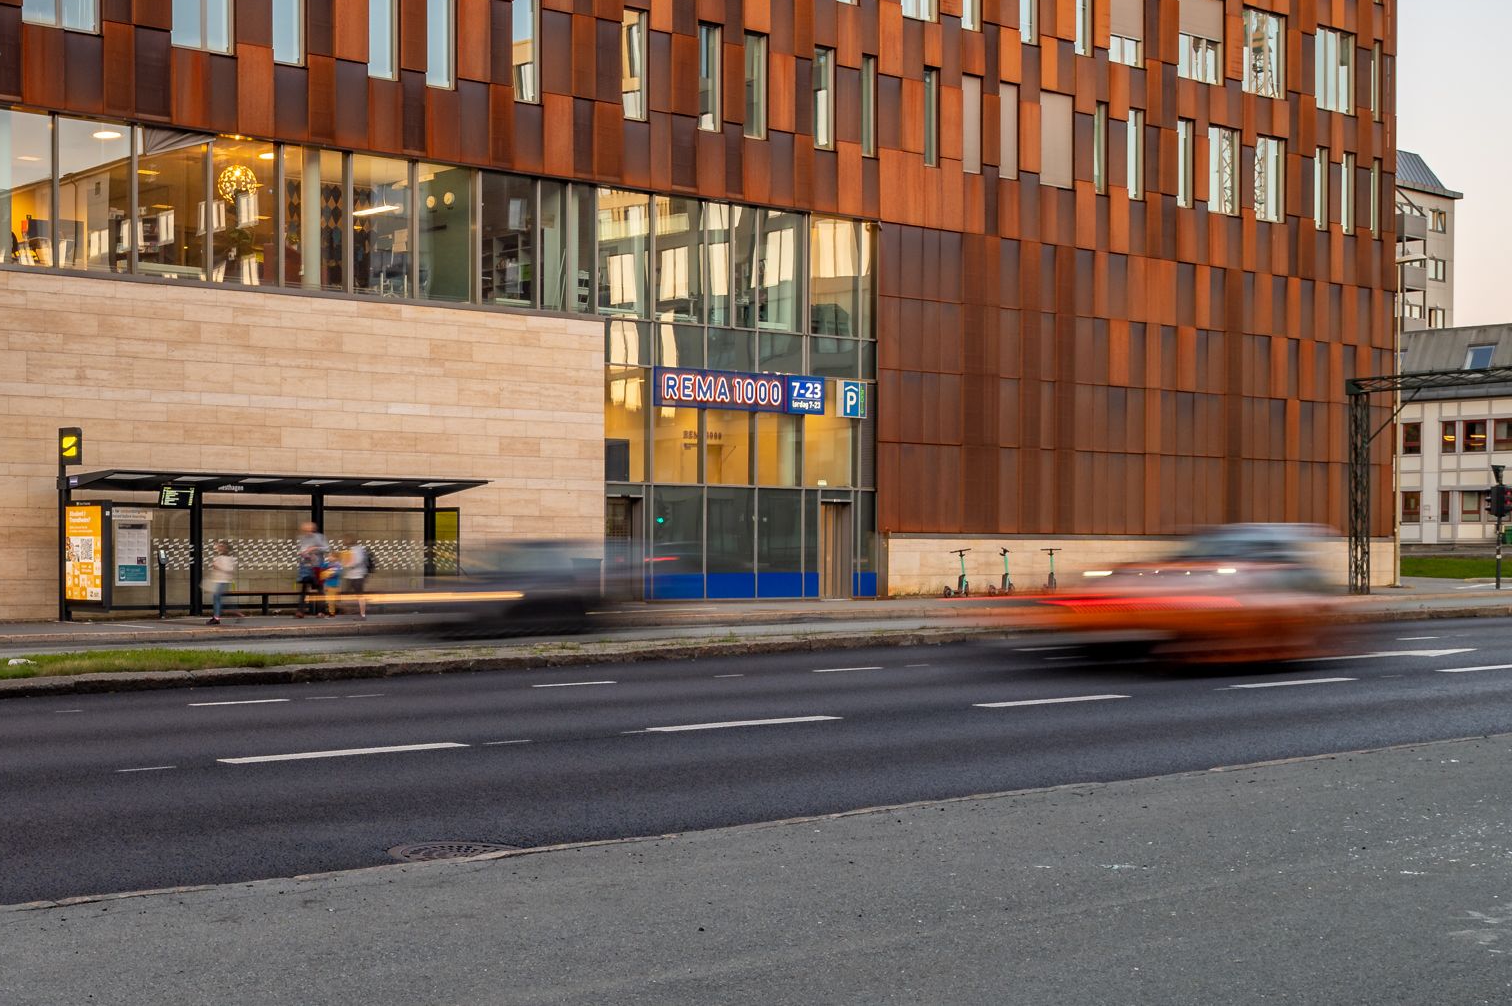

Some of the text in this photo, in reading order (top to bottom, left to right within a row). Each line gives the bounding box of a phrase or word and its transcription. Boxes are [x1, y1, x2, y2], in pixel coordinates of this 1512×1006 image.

[662, 373, 782, 406] REMA 1000
[791, 382, 822, 399] 7-23
[846, 391, 857, 414] P
